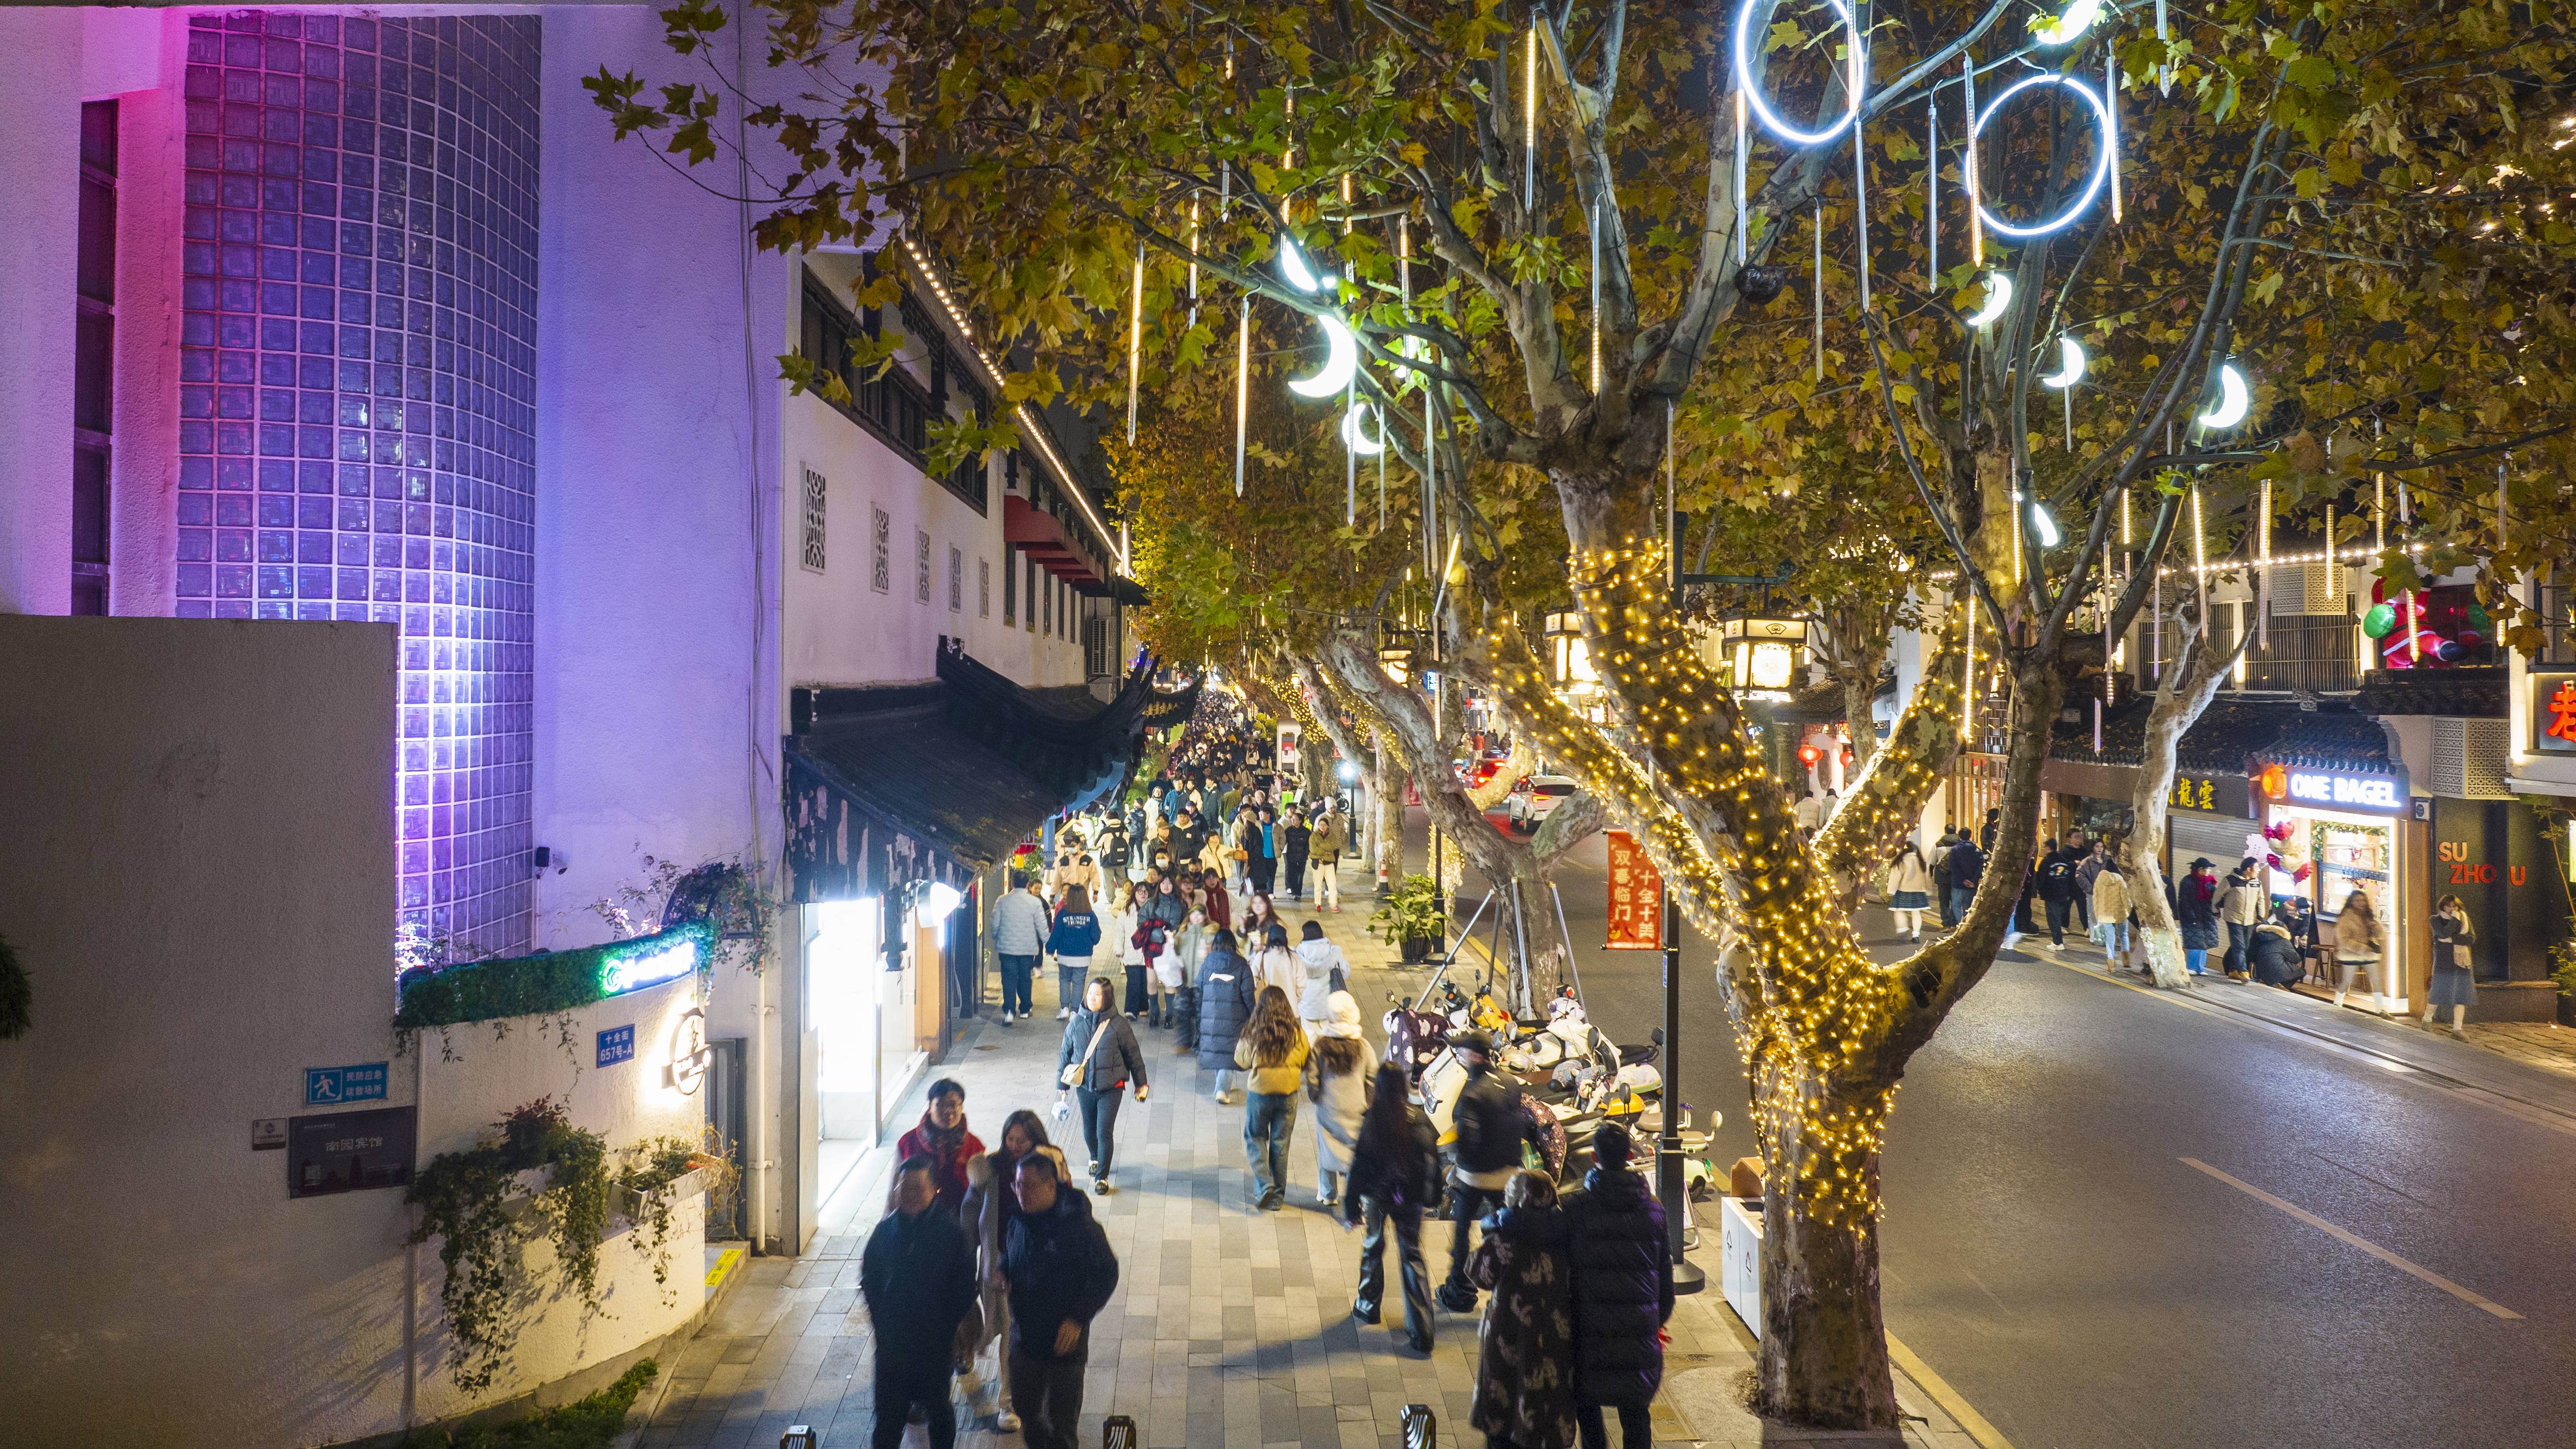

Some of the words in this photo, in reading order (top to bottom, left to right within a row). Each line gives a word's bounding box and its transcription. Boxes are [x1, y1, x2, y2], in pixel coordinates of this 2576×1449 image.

[2291, 774, 2331, 800] ONE
[2334, 777, 2401, 807] BAGEL
[2439, 841, 2467, 862] SU
[605, 1030, 629, 1044] 十全街
[600, 1044, 632, 1061] 657号-A
[325, 1136, 383, 1152] 南园宾馆
